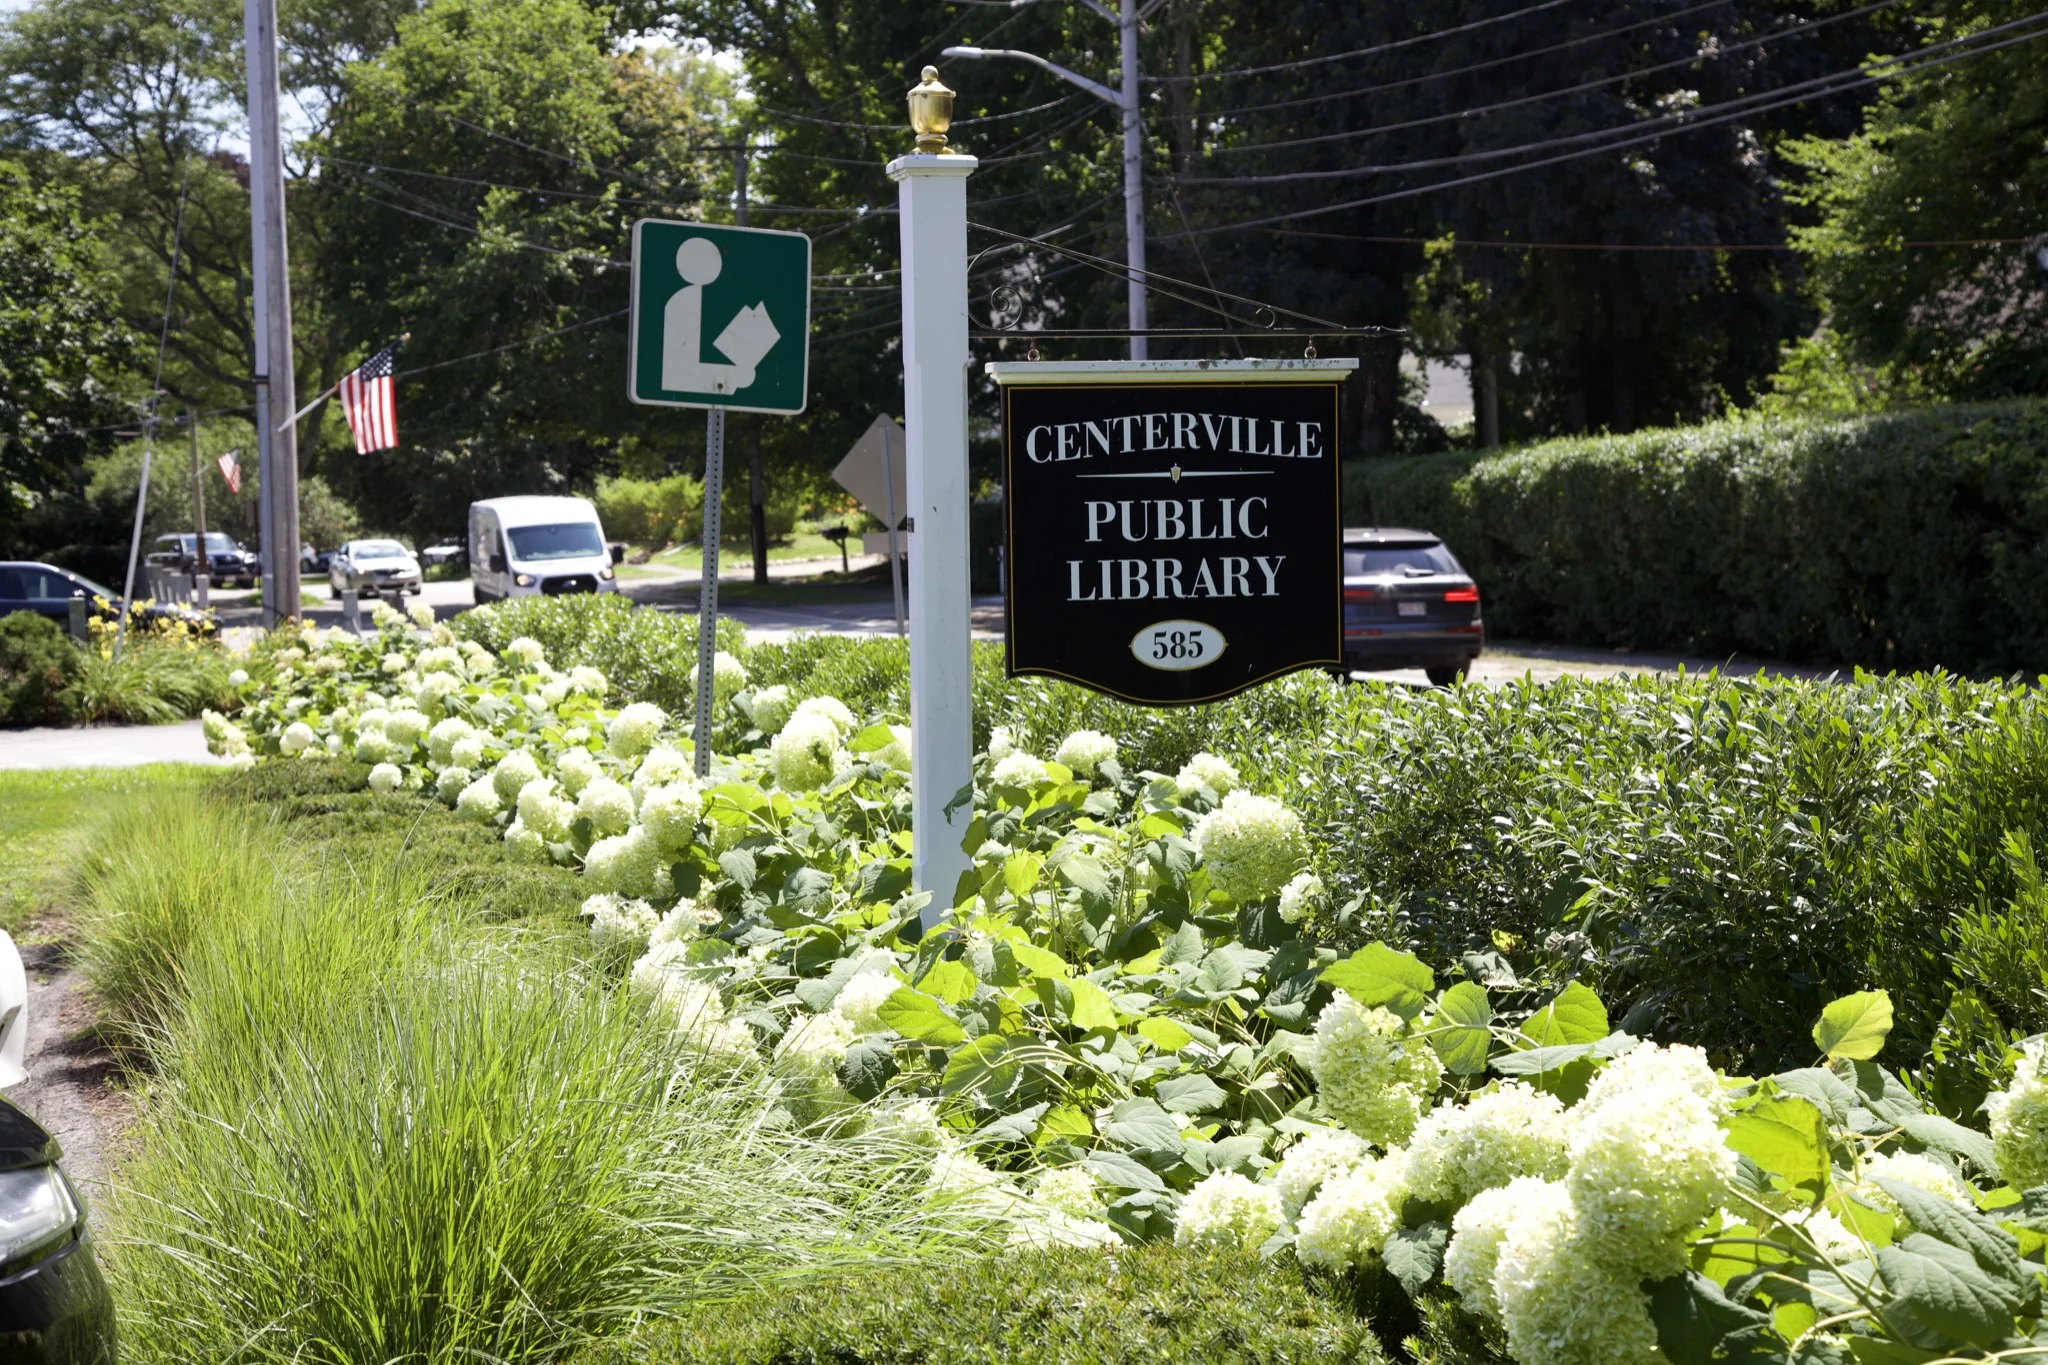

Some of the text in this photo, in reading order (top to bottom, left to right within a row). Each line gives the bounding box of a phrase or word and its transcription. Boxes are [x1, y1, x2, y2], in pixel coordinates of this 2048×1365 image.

[1026, 412, 1323, 464] CENTERVILLE
[1084, 496, 1269, 542] PUBLIC
[1066, 555, 1286, 601] LIBRARY
[1152, 630, 1204, 659] 585
